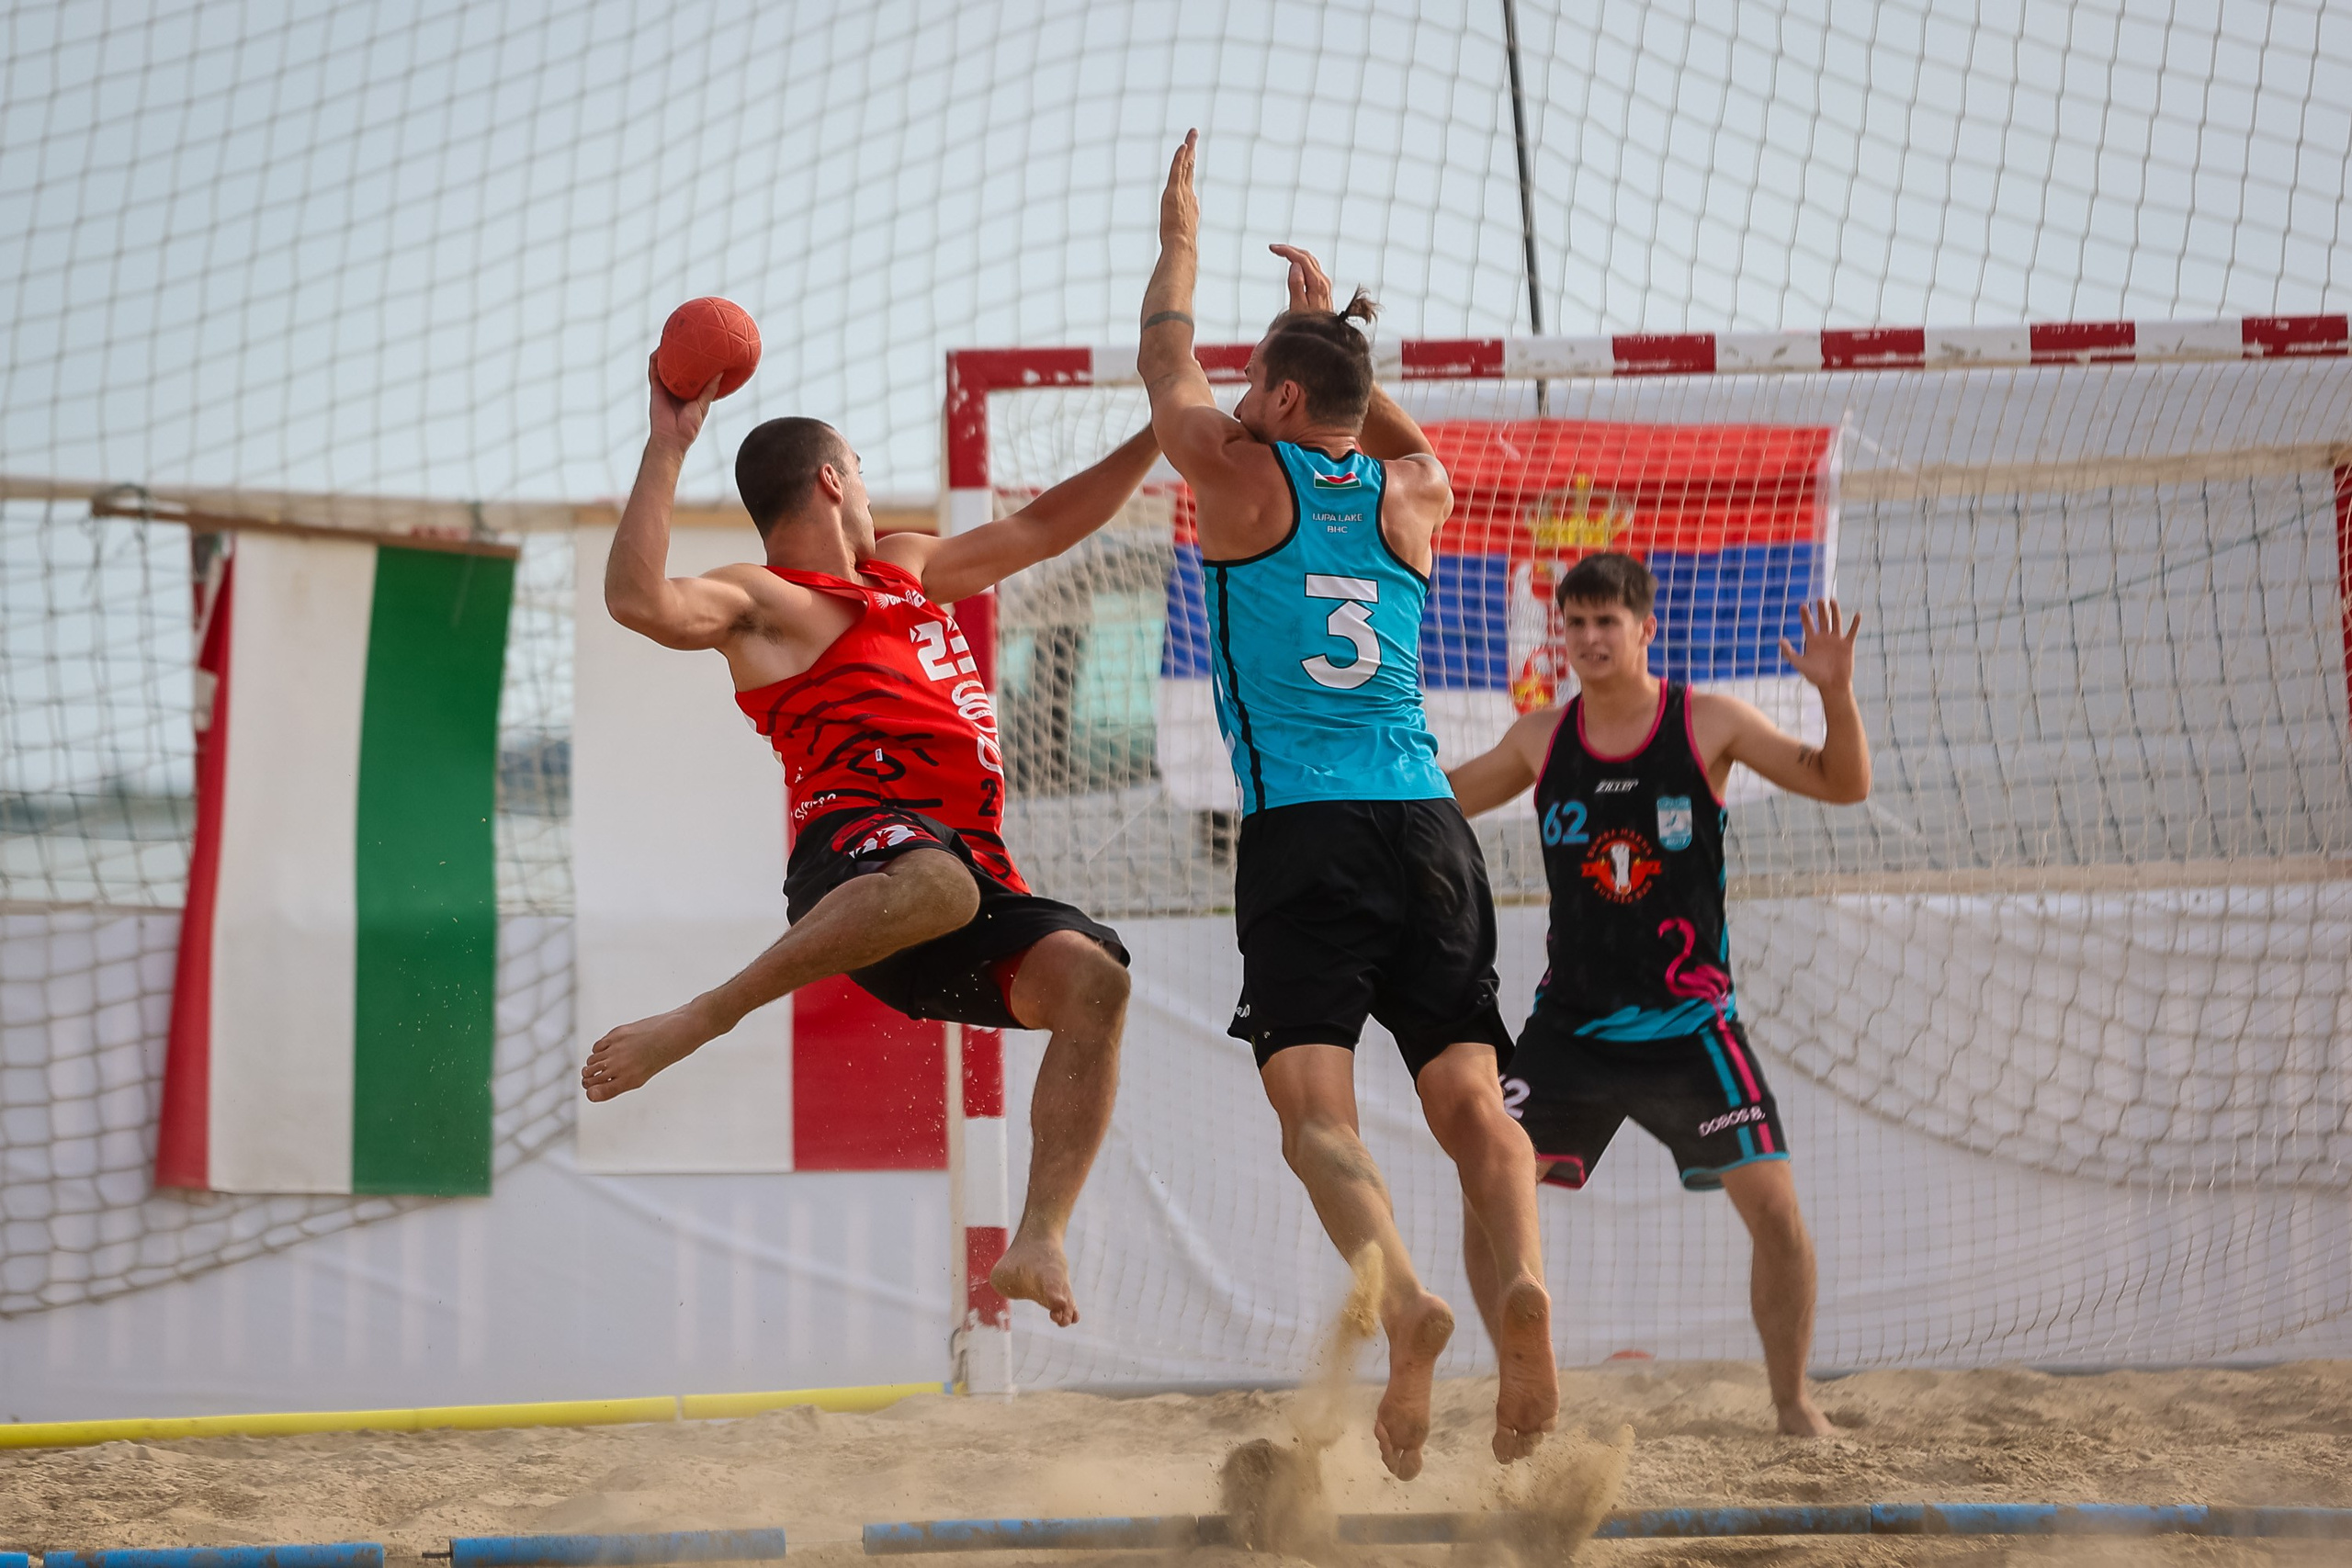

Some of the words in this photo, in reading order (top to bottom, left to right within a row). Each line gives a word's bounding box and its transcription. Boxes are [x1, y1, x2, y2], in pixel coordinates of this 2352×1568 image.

[1312, 513, 1337, 522] LUPA
[1338, 513, 1363, 522] LAKE
[1327, 525, 1348, 534] BHC
[1300, 572, 1382, 689] 3
[1543, 800, 1589, 846] 62
[1698, 1107, 1750, 1138] DOBOS
